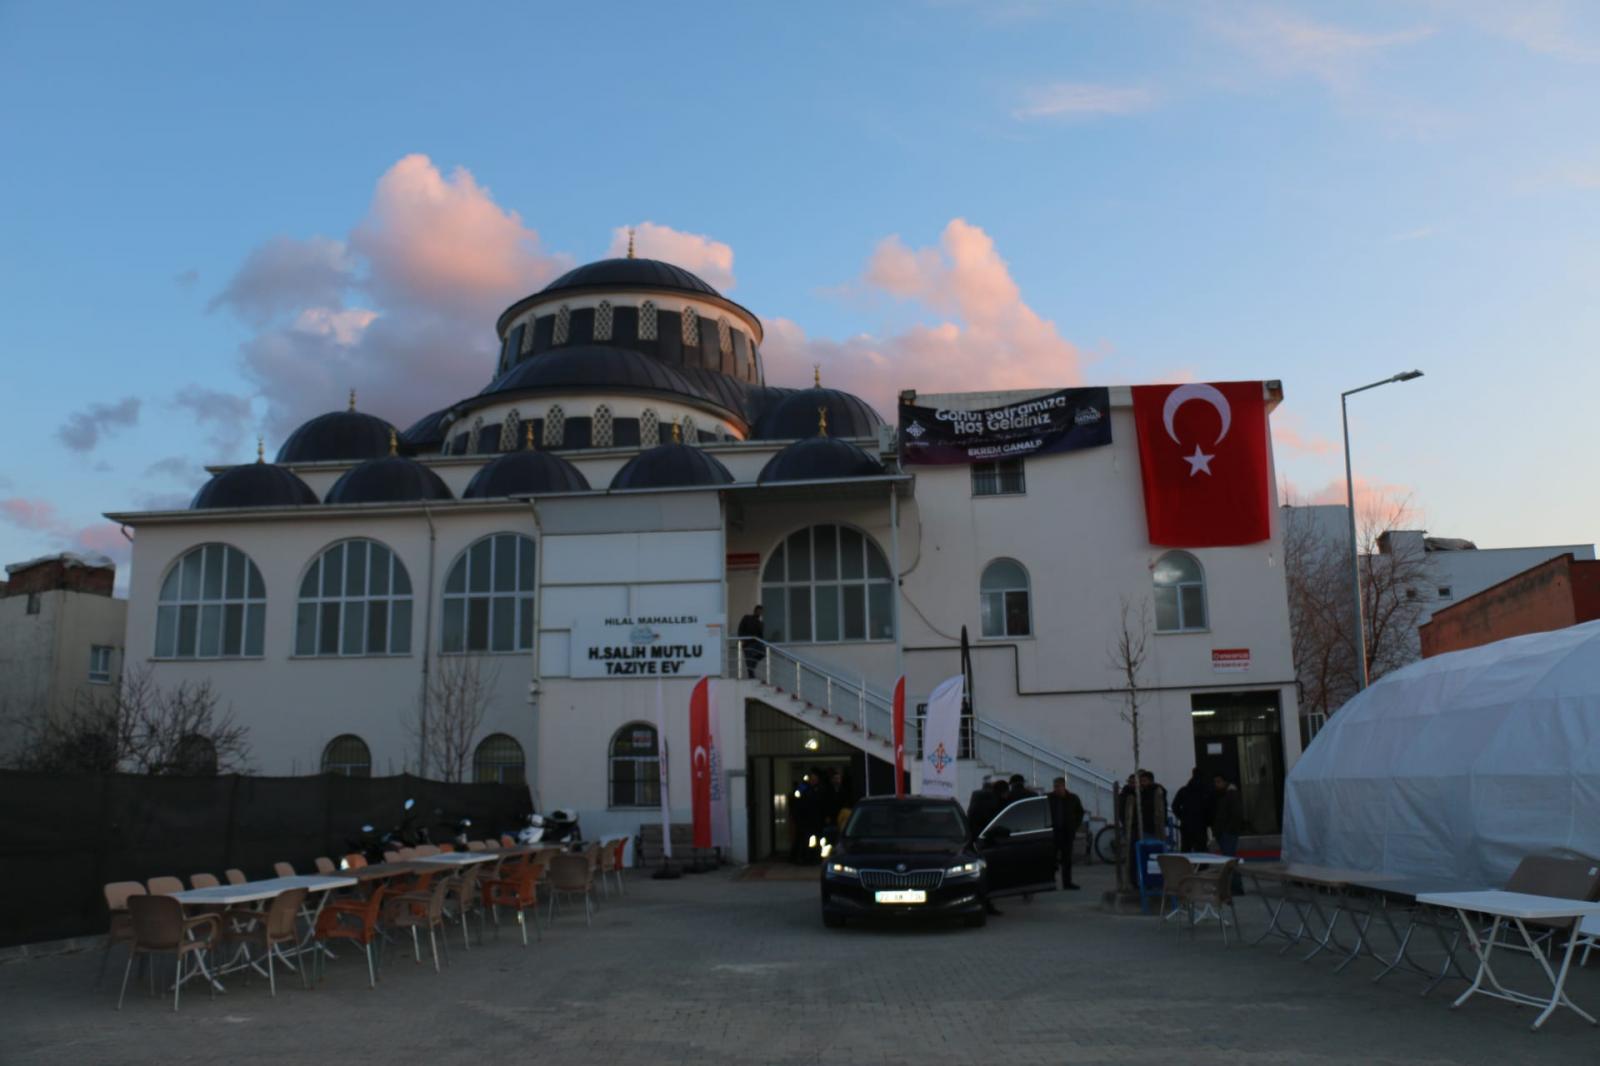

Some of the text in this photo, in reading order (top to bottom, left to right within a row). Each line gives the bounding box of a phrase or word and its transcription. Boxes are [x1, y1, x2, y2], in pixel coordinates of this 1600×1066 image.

[954, 420, 984, 436] Hoş
[987, 412, 1051, 431] Geldiniz
[967, 445, 1002, 456] EKREM
[1002, 439, 1043, 452] CANALP
[651, 645, 702, 658] MUTLU
[661, 660, 685, 674] EV
